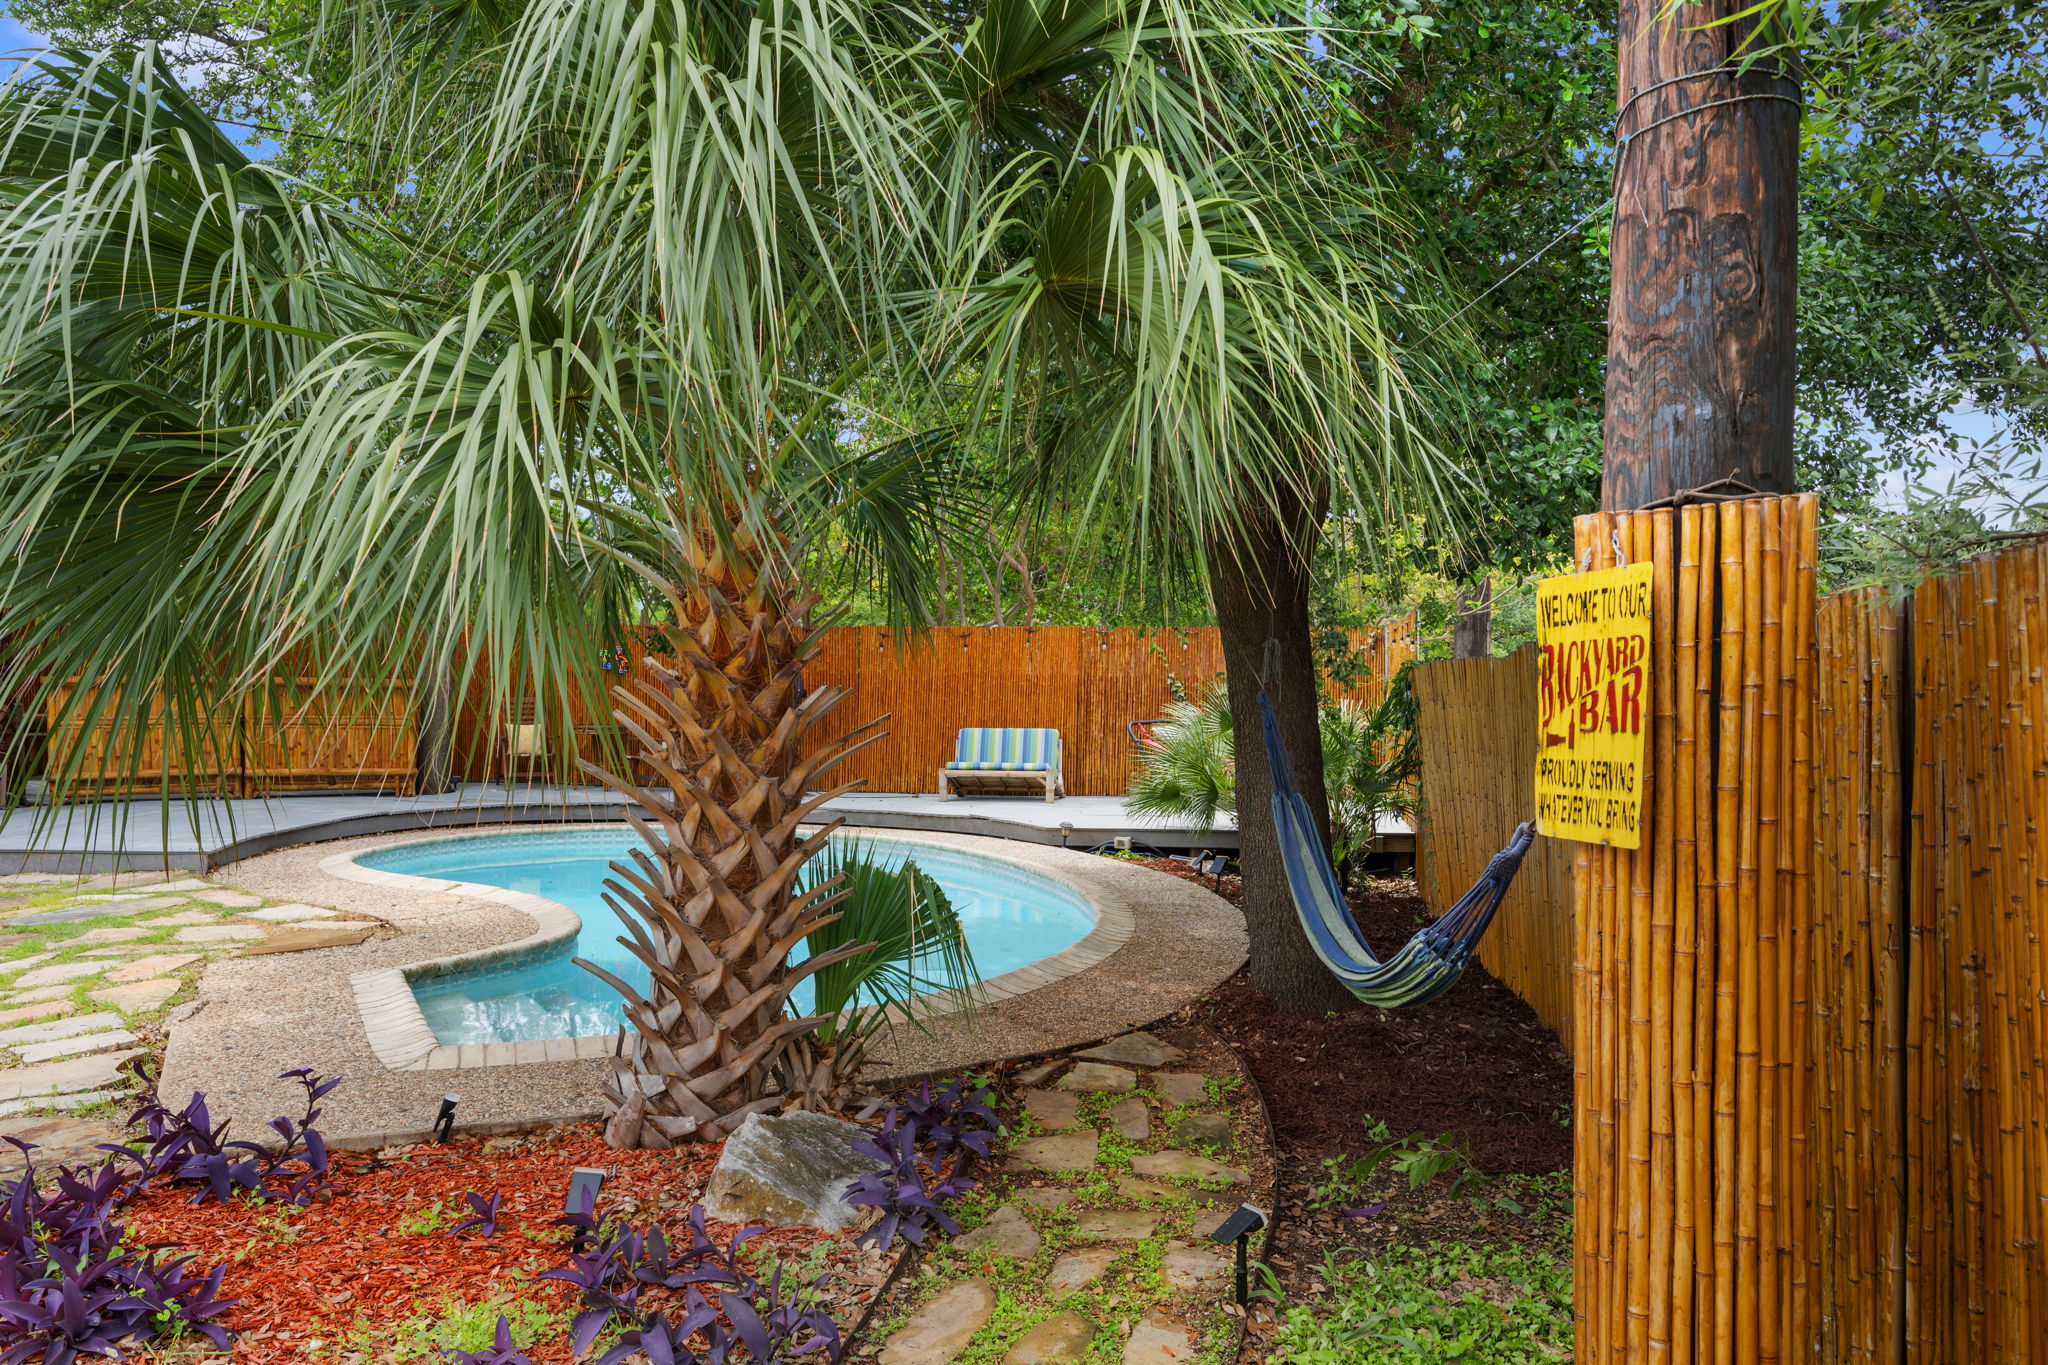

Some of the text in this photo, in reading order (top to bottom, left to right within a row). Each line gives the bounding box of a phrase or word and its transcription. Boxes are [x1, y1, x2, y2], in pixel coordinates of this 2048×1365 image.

[1540, 582, 1647, 629] WELCOME TO OUR
[1541, 635, 1645, 729] BACKYARD
[1580, 665, 1643, 734] BAR
[1541, 759, 1635, 793] PROUDLY SERVING
[1538, 793, 1636, 832] WHATEVER YOU BRING
